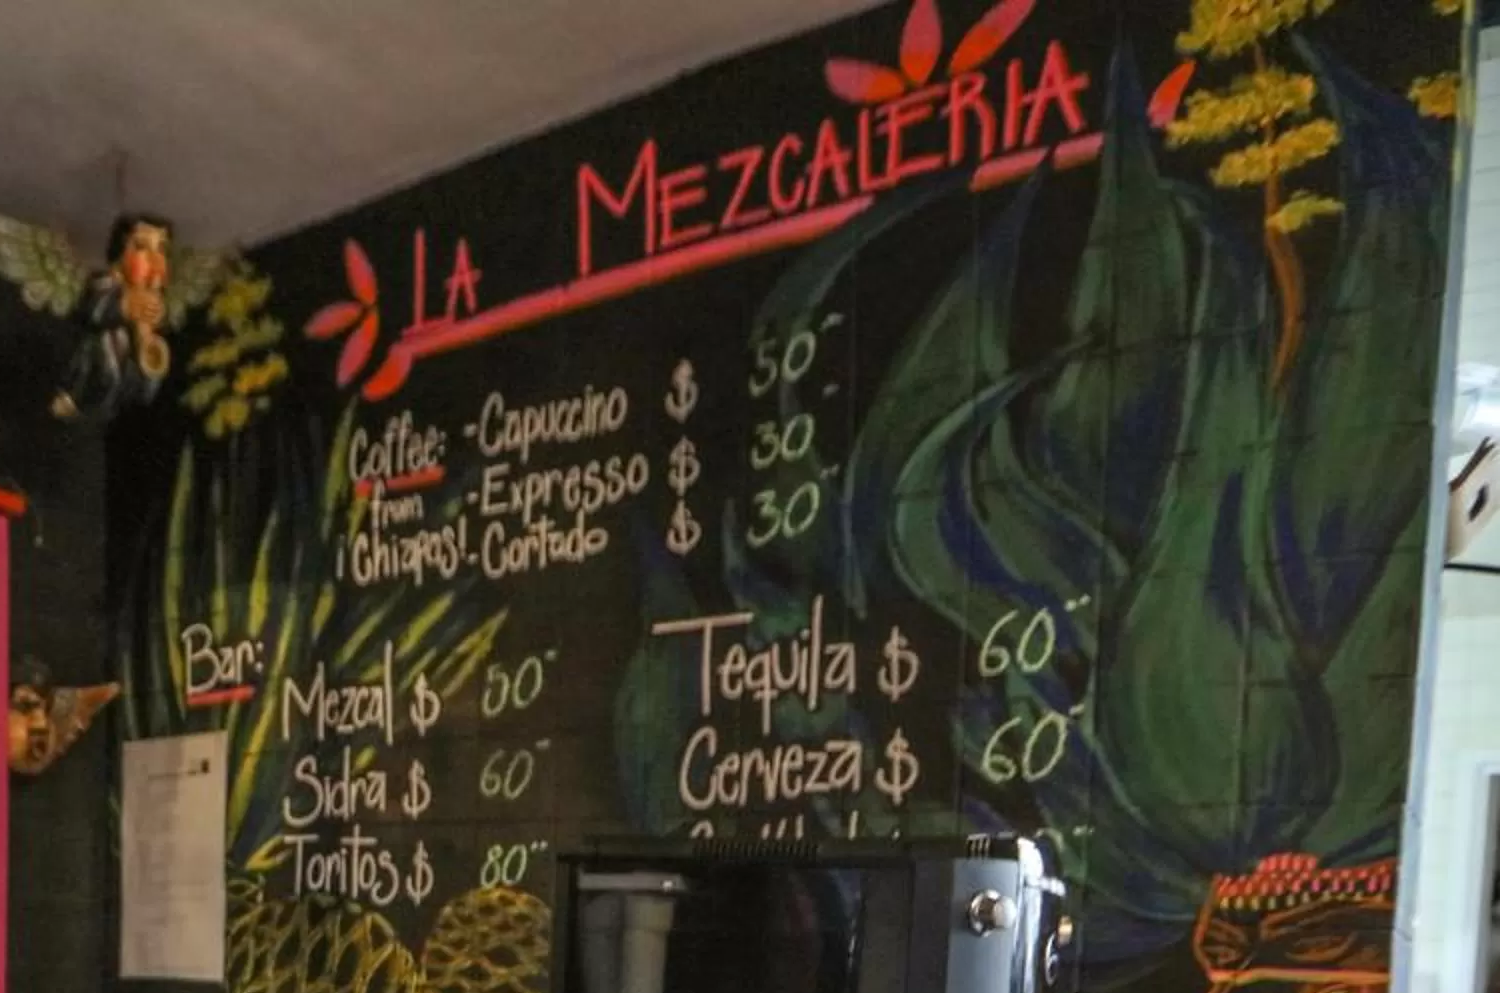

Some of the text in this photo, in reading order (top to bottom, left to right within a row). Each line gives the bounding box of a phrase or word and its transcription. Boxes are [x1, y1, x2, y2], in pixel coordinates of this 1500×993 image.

[402, 40, 1089, 338] LA MEZCALERIA
[663, 357, 699, 424] $
[667, 434, 701, 497] $
[665, 499, 702, 557] $
[282, 640, 394, 745] Mezcal
[409, 672, 441, 736] $
[651, 594, 856, 734] Tequila
[876, 626, 920, 702] $
[283, 745, 387, 827] Sidra
[403, 758, 432, 819] $
[679, 726, 862, 810] Cerveza
[875, 728, 920, 806] $
[284, 825, 399, 905] Toritos
[406, 840, 435, 906] $
